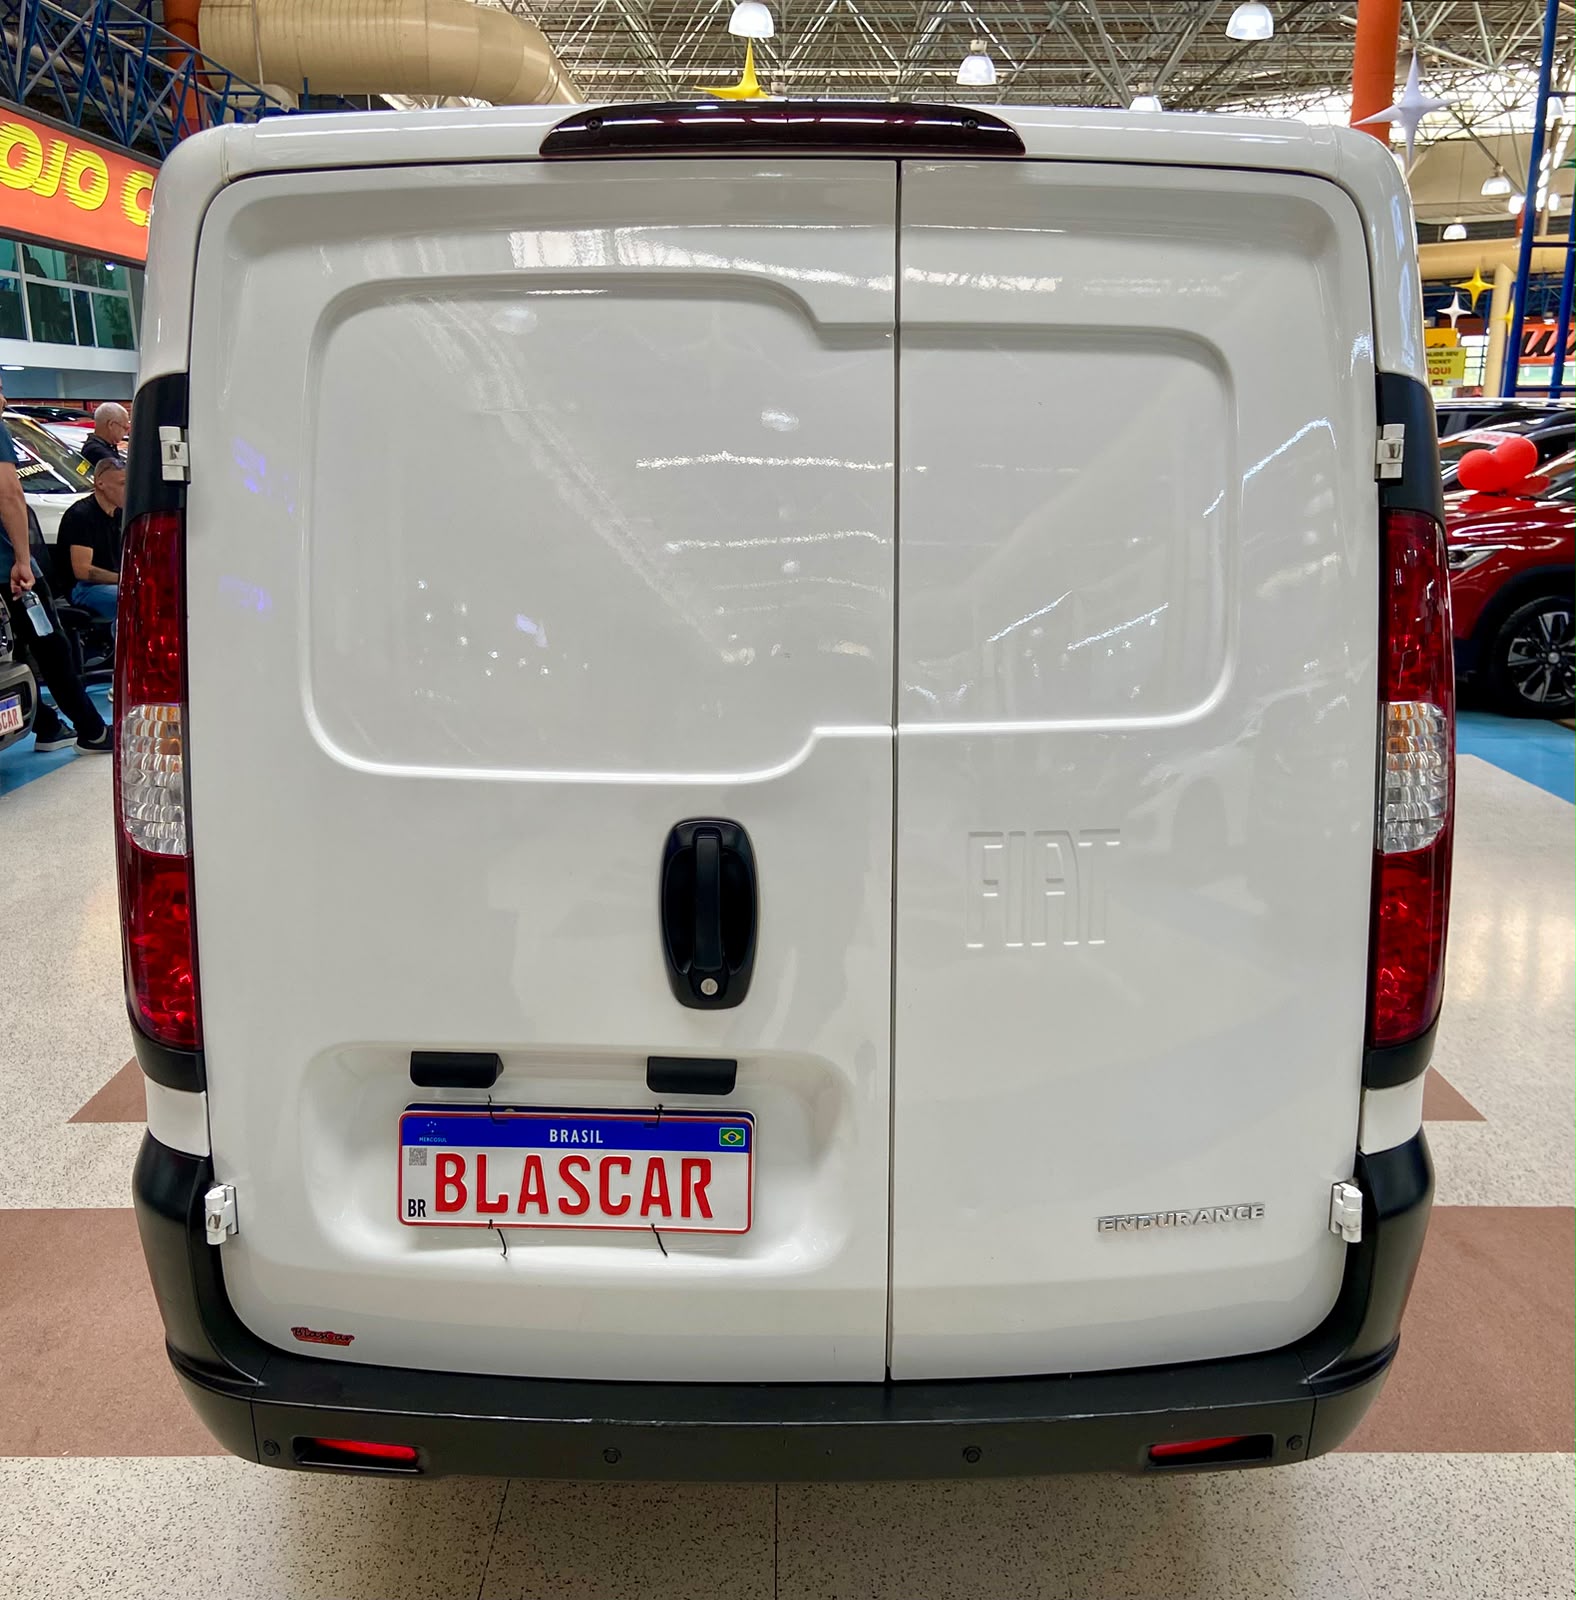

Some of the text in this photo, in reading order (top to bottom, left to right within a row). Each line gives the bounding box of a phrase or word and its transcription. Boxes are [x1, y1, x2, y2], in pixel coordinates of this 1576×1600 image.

[0, 708, 19, 731] CAR
[966, 829, 1120, 948] FIAT
[549, 1128, 604, 1144] BRASIL
[435, 1152, 714, 1219] BLASCAR
[407, 1198, 426, 1218] BR
[1097, 1203, 1265, 1232] ENDURANCE
